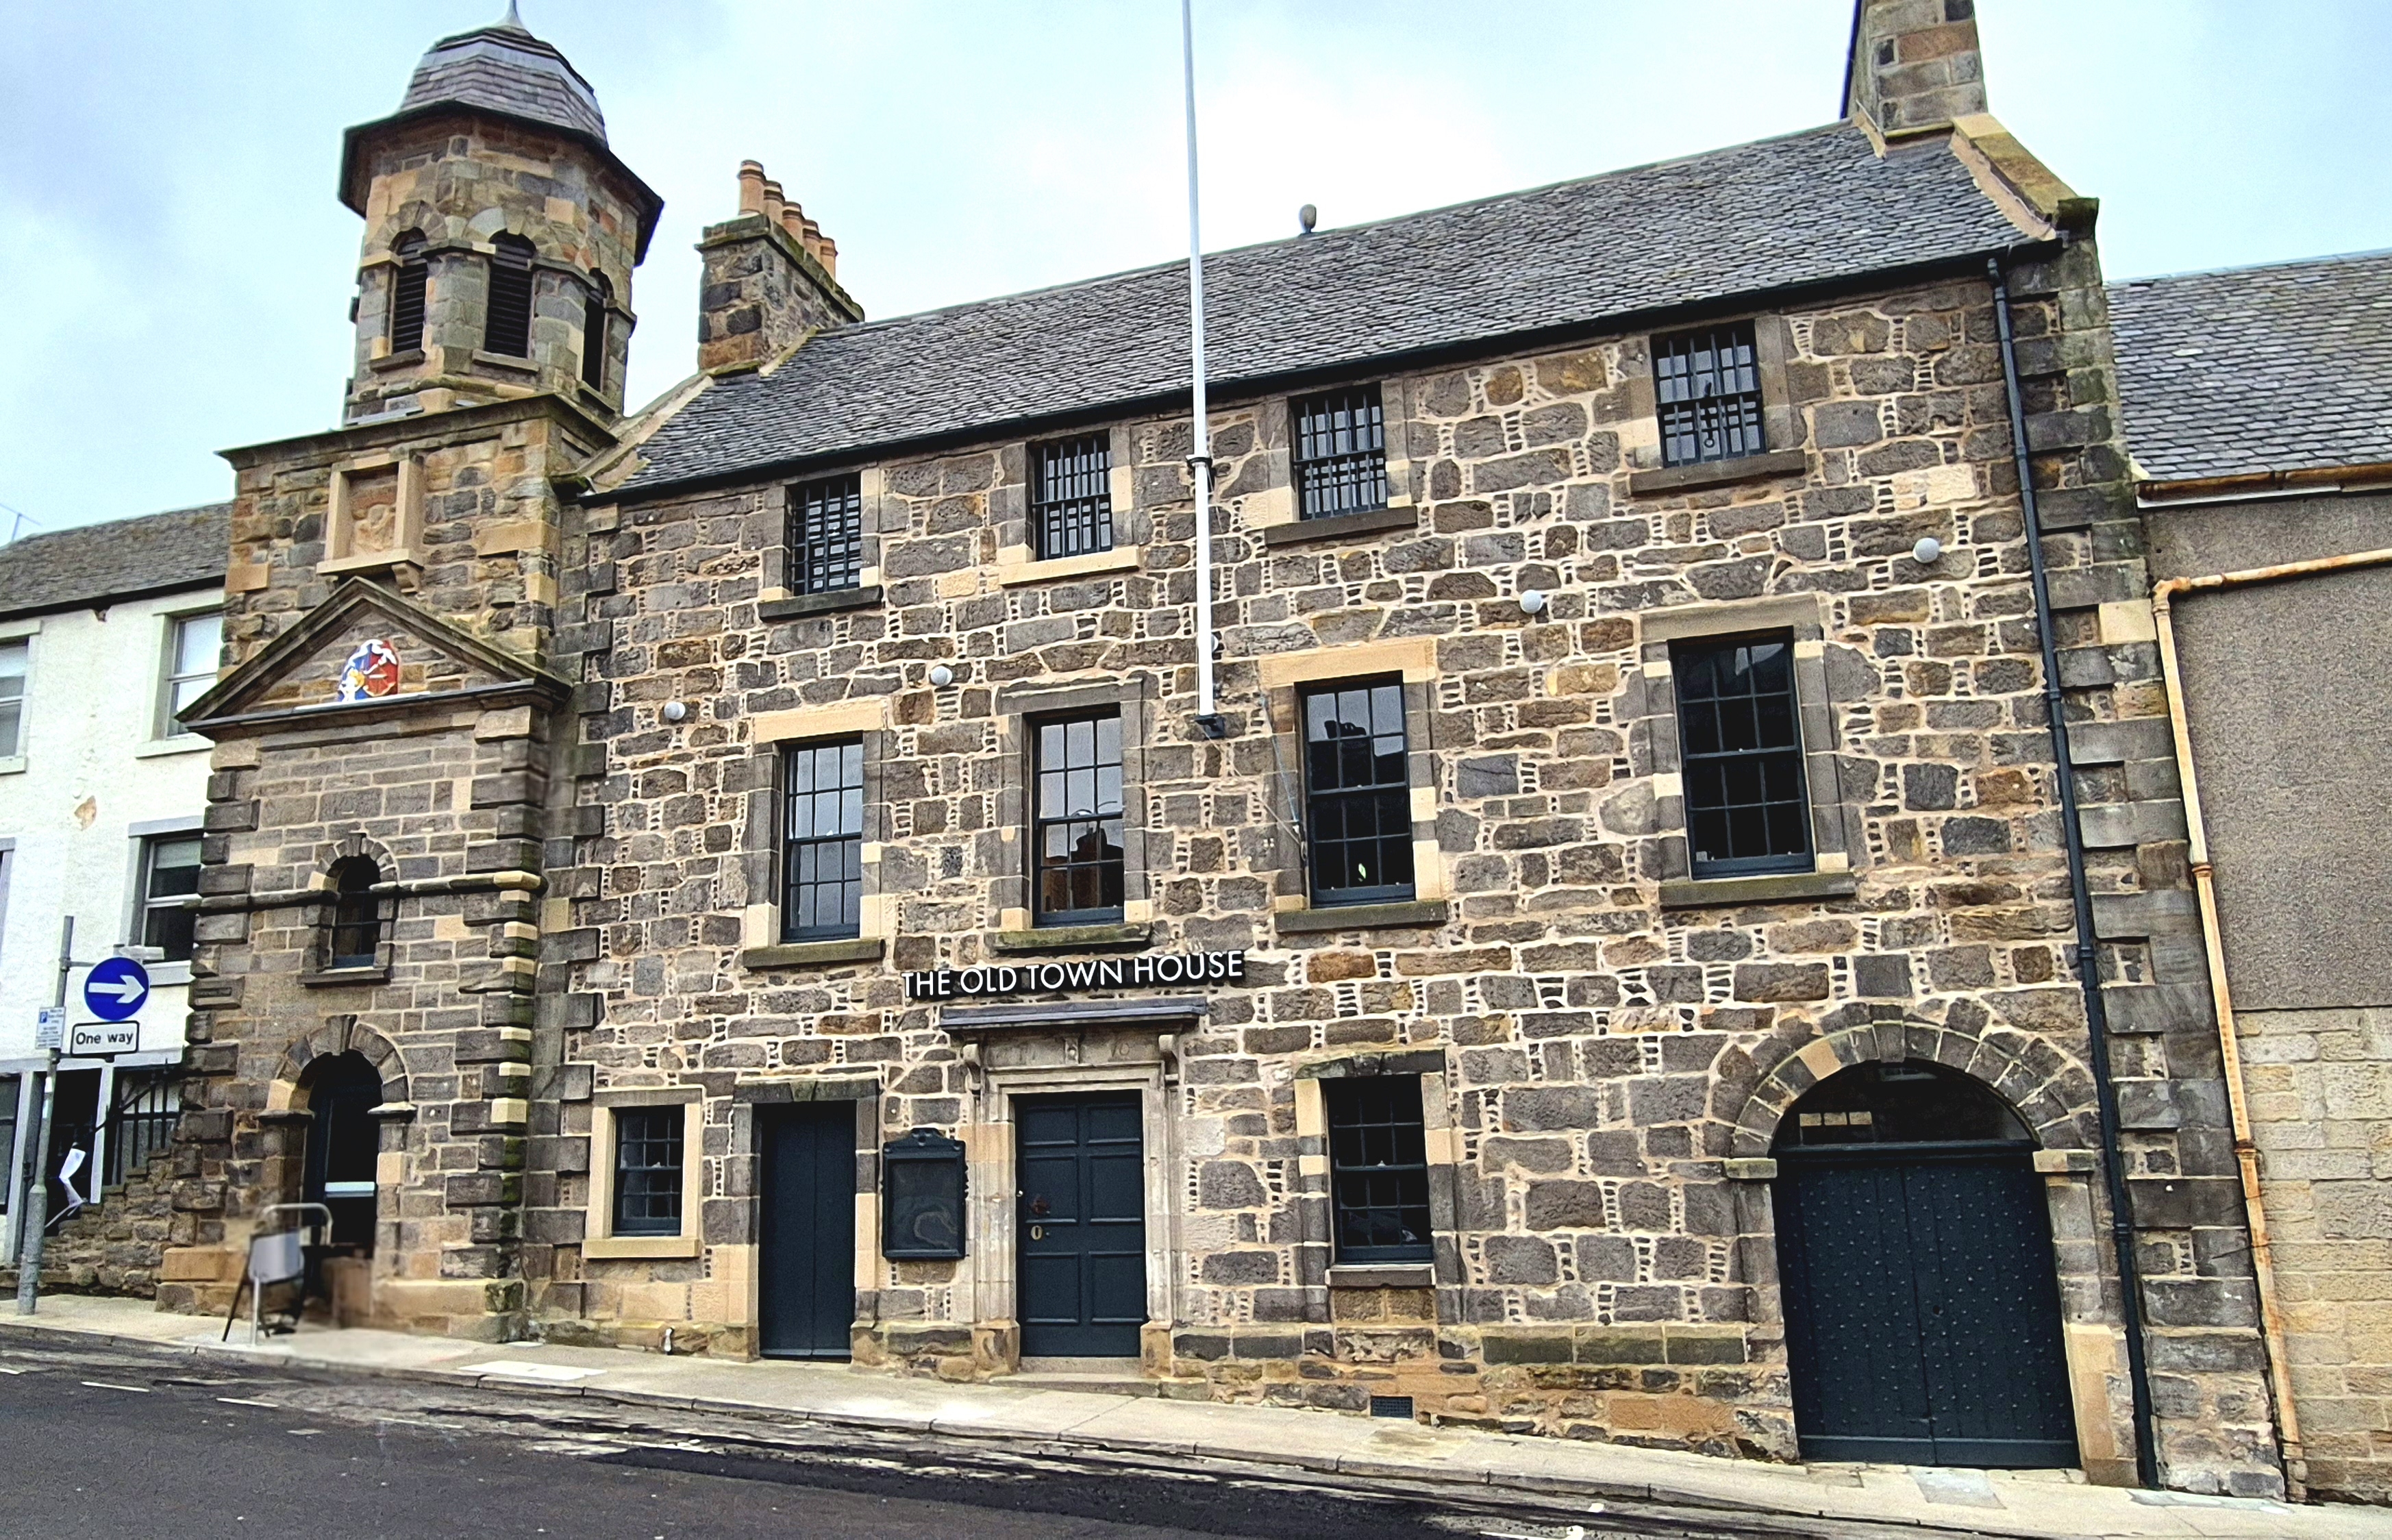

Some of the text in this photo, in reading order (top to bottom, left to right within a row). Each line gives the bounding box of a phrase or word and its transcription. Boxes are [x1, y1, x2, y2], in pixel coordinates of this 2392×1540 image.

[901, 950, 1243, 997] THE OLD TOWN HOUSE
[75, 1032, 134, 1045] One way
